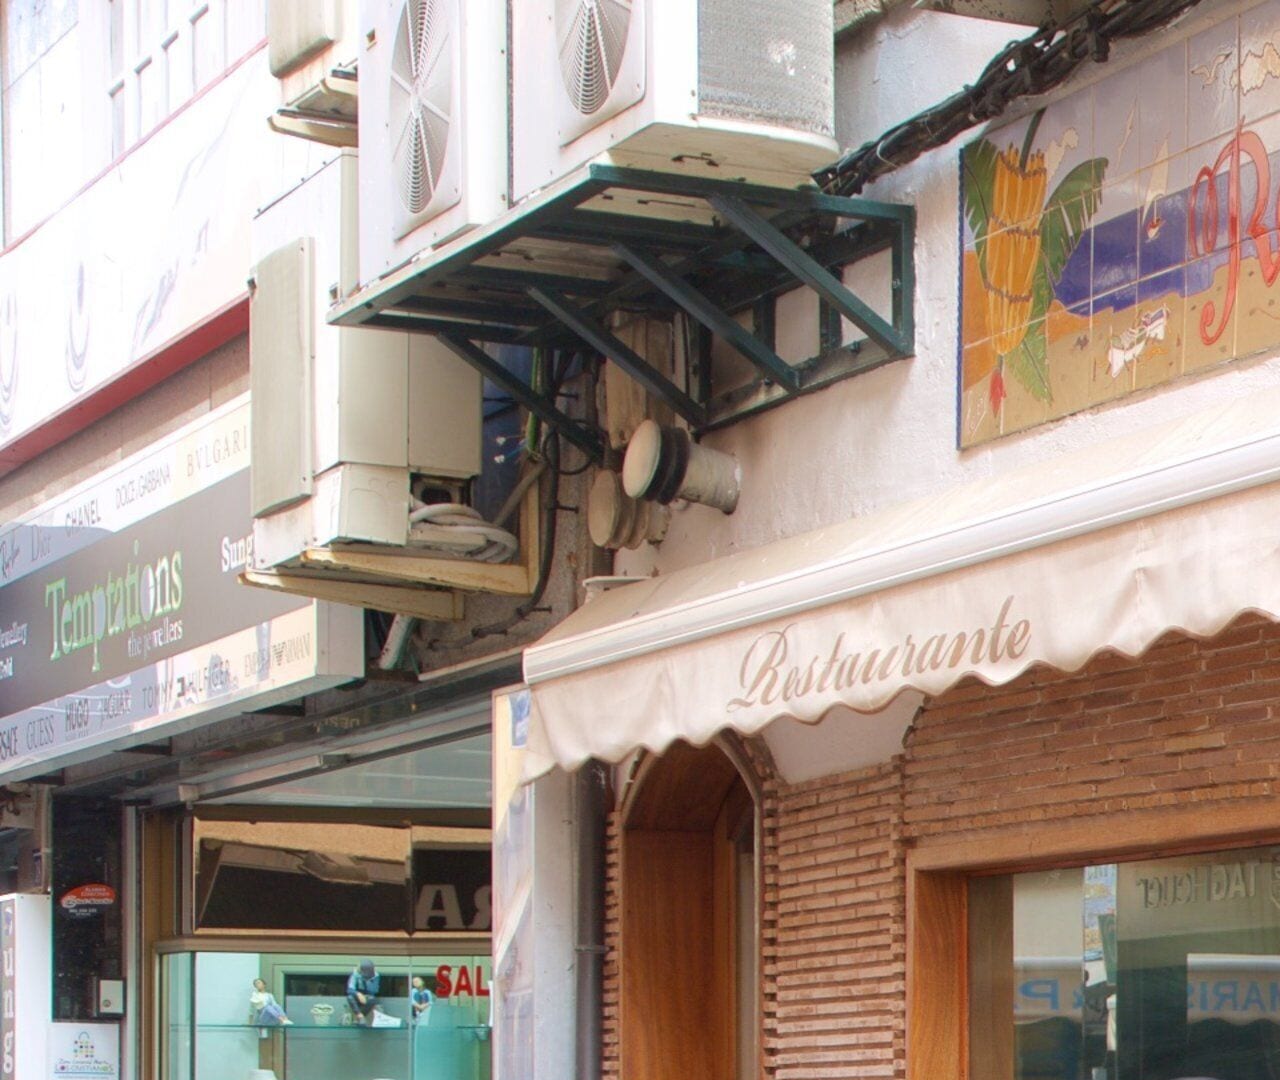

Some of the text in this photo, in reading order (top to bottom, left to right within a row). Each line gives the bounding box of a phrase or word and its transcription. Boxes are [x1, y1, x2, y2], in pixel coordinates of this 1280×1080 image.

[187, 425, 248, 477] BVLGARI
[65, 499, 101, 538] CHANEL
[45, 540, 183, 673] Temptations
[128, 630, 142, 657] the
[727, 595, 1032, 713] Restaurante
[27, 715, 55, 751] GUESS
[65, 698, 90, 733] HUGO
